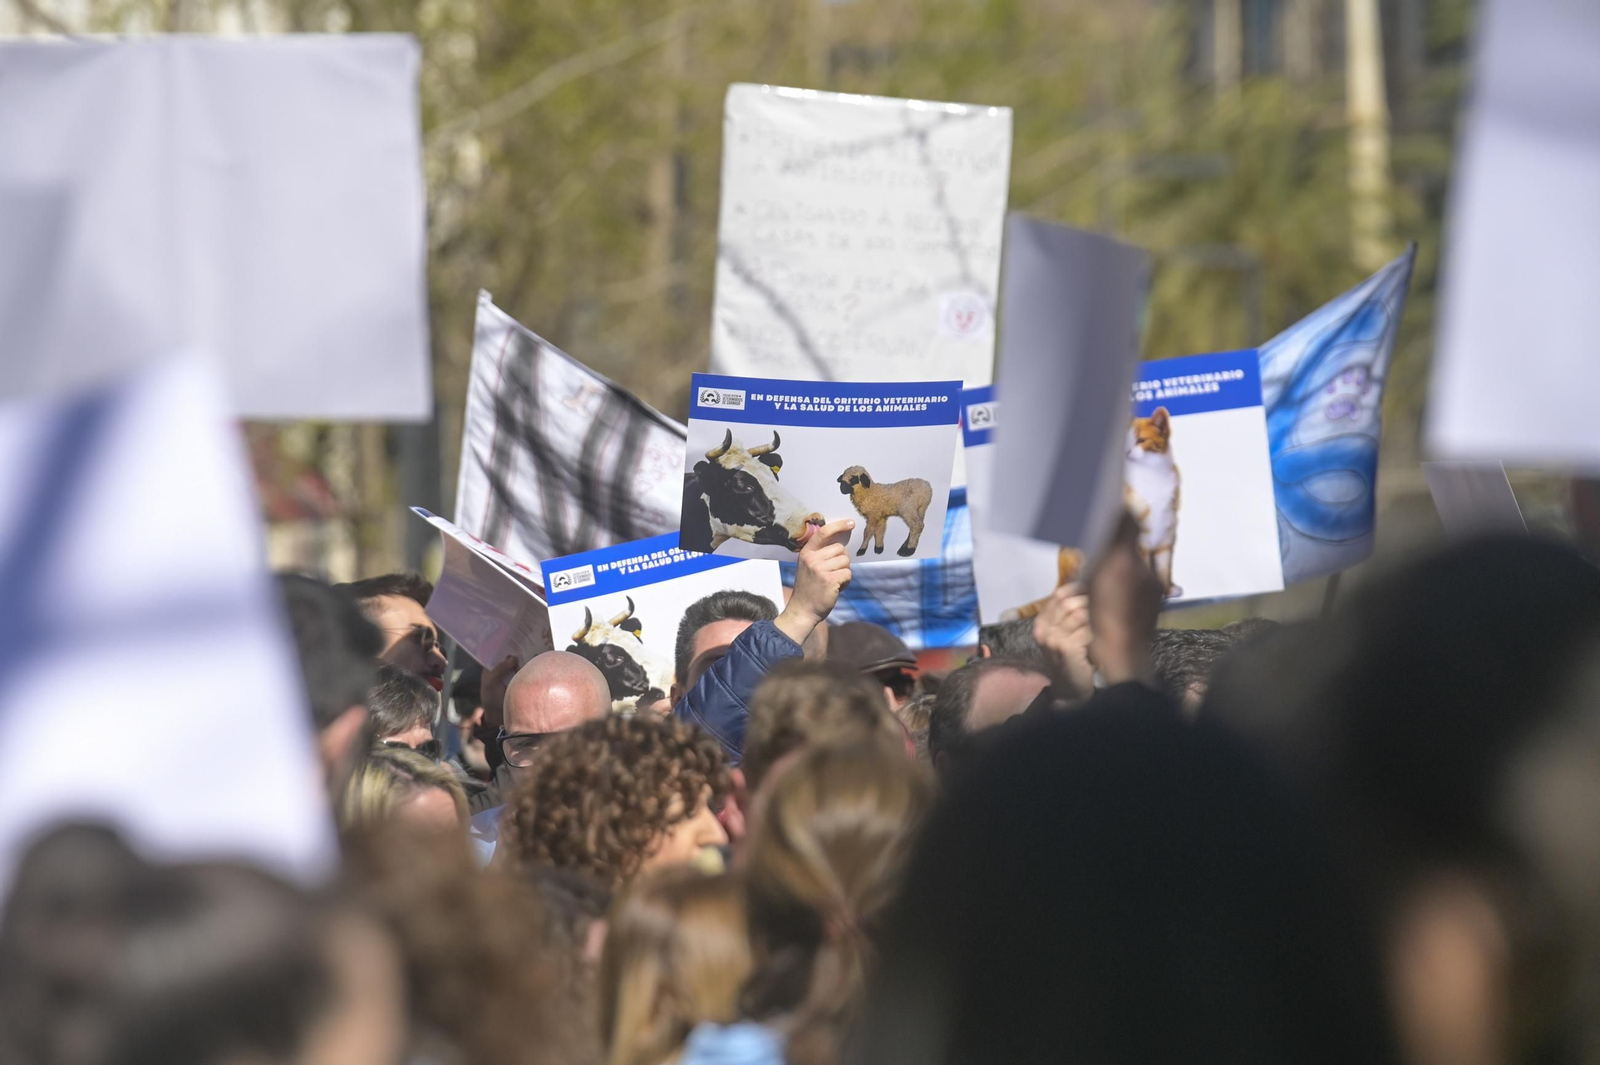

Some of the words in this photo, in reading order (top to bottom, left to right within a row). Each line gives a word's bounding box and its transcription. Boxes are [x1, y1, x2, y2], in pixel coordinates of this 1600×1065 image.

[1161, 369, 1244, 388] VETERINARIO
[750, 393, 764, 401] EN
[766, 394, 811, 404] DEFENSA
[812, 396, 832, 404] DEL
[833, 397, 881, 405] CRITERIO
[883, 395, 949, 405] VETERINARIO
[1154, 381, 1221, 400] ANIMALES
[774, 402, 782, 410] Y
[783, 403, 798, 411] LA
[799, 403, 835, 412] SALUD
[837, 404, 851, 412] DE
[852, 404, 873, 413] LOS
[875, 403, 928, 413] ANIMALES
[596, 563, 610, 573] EN
[610, 554, 650, 570] DEFENSA
[650, 550, 668, 560] DEL
[618, 566, 626, 575] Y
[627, 564, 641, 573] LA
[641, 557, 673, 570] SALUD
[673, 553, 686, 563] DE
